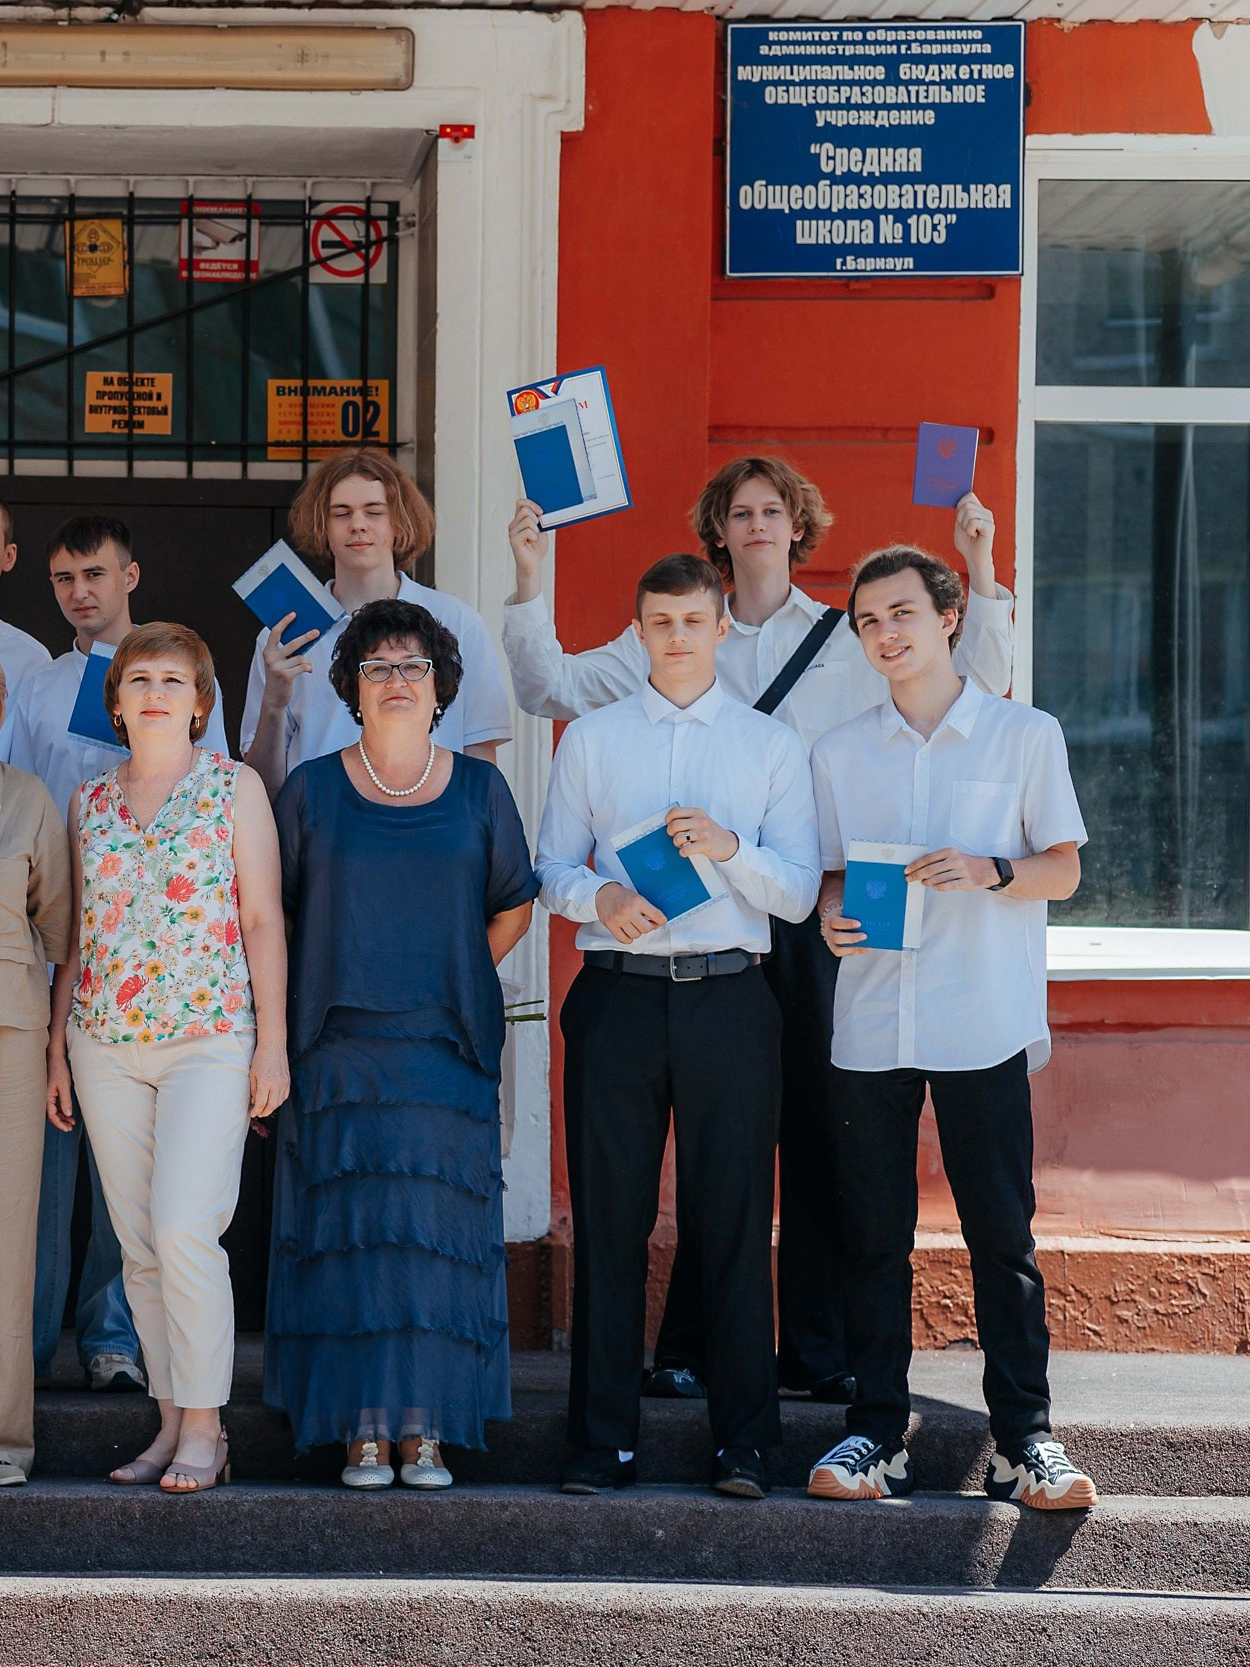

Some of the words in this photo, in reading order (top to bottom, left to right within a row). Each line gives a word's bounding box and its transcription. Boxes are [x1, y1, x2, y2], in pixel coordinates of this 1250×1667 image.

[768, 30, 839, 41] комитет
[842, 31, 862, 41] по
[866, 29, 983, 42] образованию
[759, 43, 897, 56] администрации
[900, 42, 992, 55] г.Барнаула
[737, 64, 885, 83] муниципальное
[764, 84, 986, 106] ОБЩЕОБРАЗОВАТЕЛЬНОЕ
[815, 109, 936, 128] учреждение
[810, 142, 922, 177] “Средняя
[739, 180, 1011, 213] общеобразовательная
[796, 219, 874, 244] школа
[879, 214, 903, 244] №
[907, 213, 957, 245] 103”
[836, 256, 914, 271] г.Барнаул
[103, 376, 115, 386] НА
[156, 392, 162, 402] И
[342, 400, 381, 438] 02
